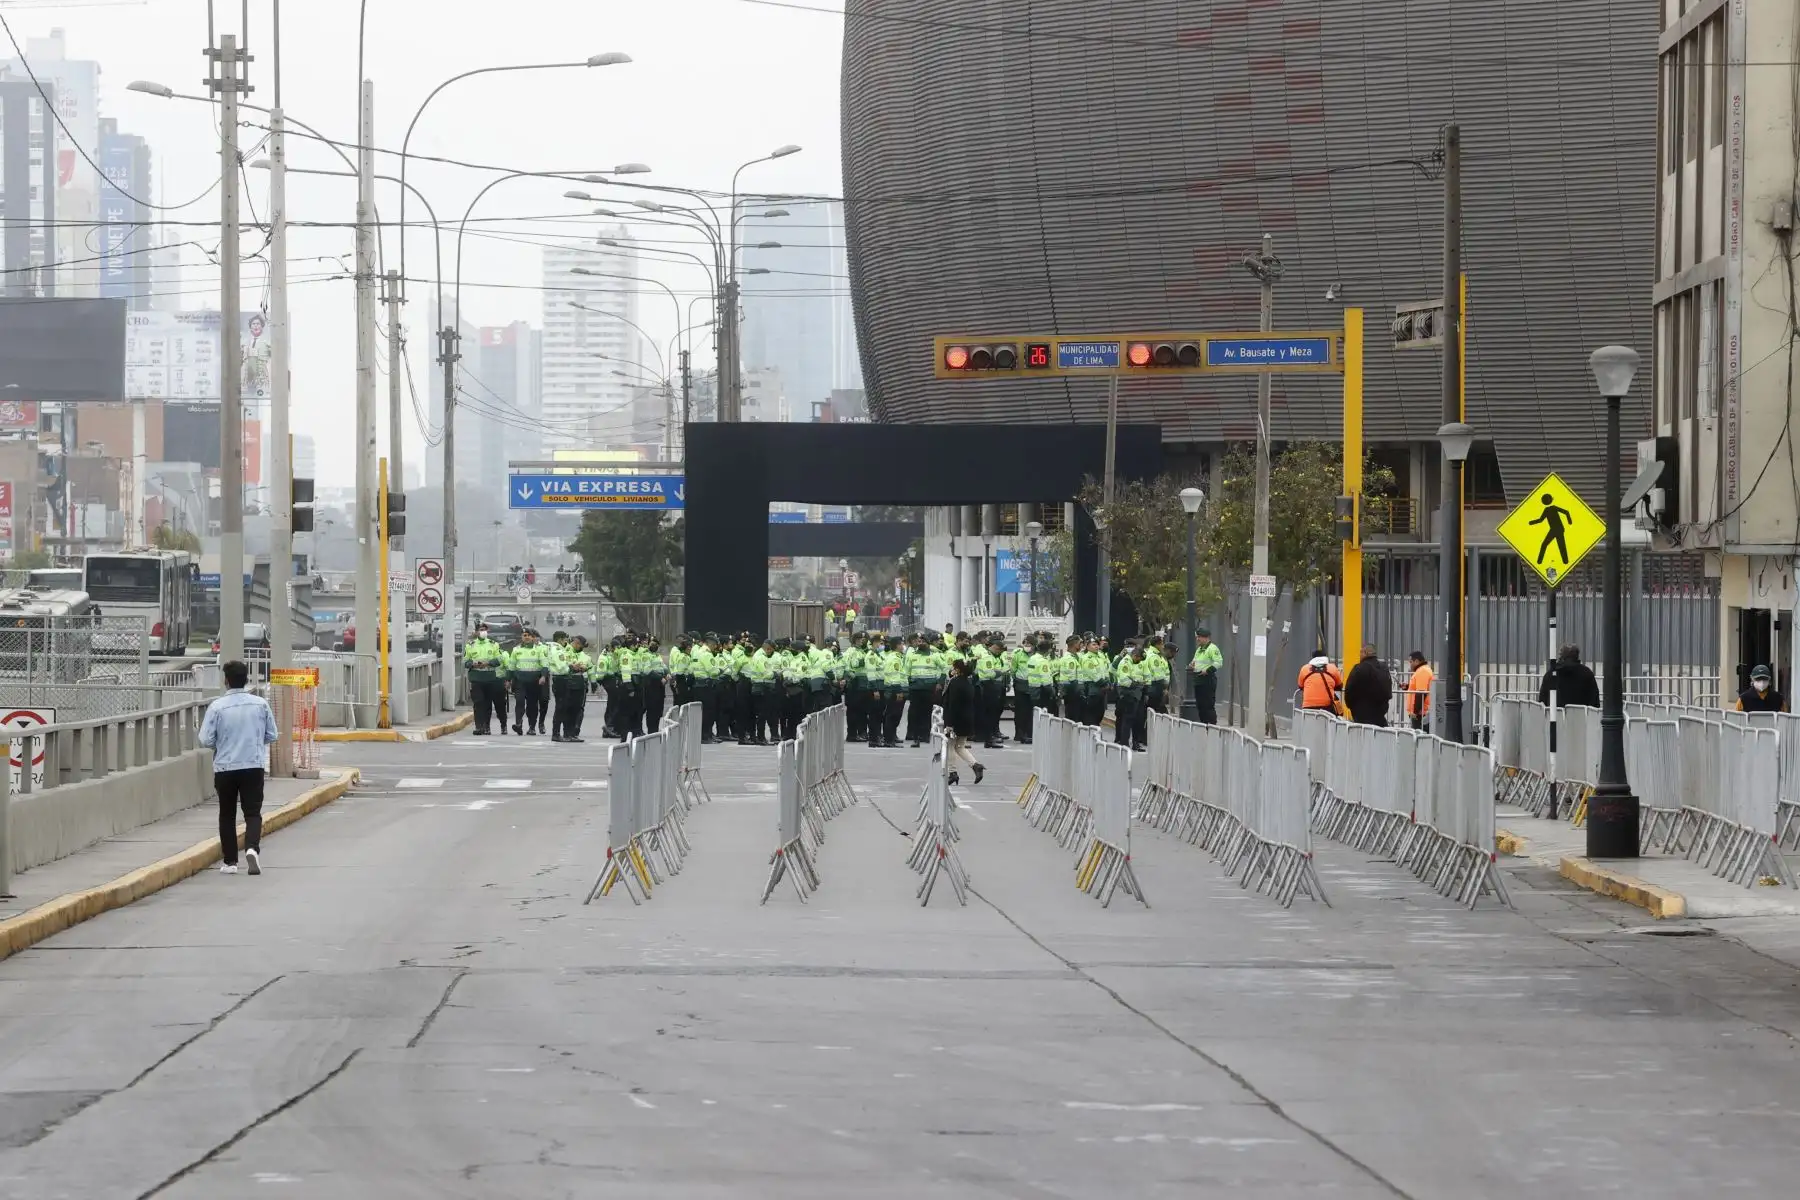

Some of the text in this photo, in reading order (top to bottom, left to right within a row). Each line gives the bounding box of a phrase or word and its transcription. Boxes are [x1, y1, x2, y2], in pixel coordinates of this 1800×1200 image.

[1031, 347, 1046, 365] 26
[1059, 345, 1118, 355] MUNICIPALIDAD
[1224, 346, 1312, 359] Av. Bausate y Meza
[1073, 356, 1104, 365] DE LIMA
[540, 480, 664, 493] VIA EXPRESA
